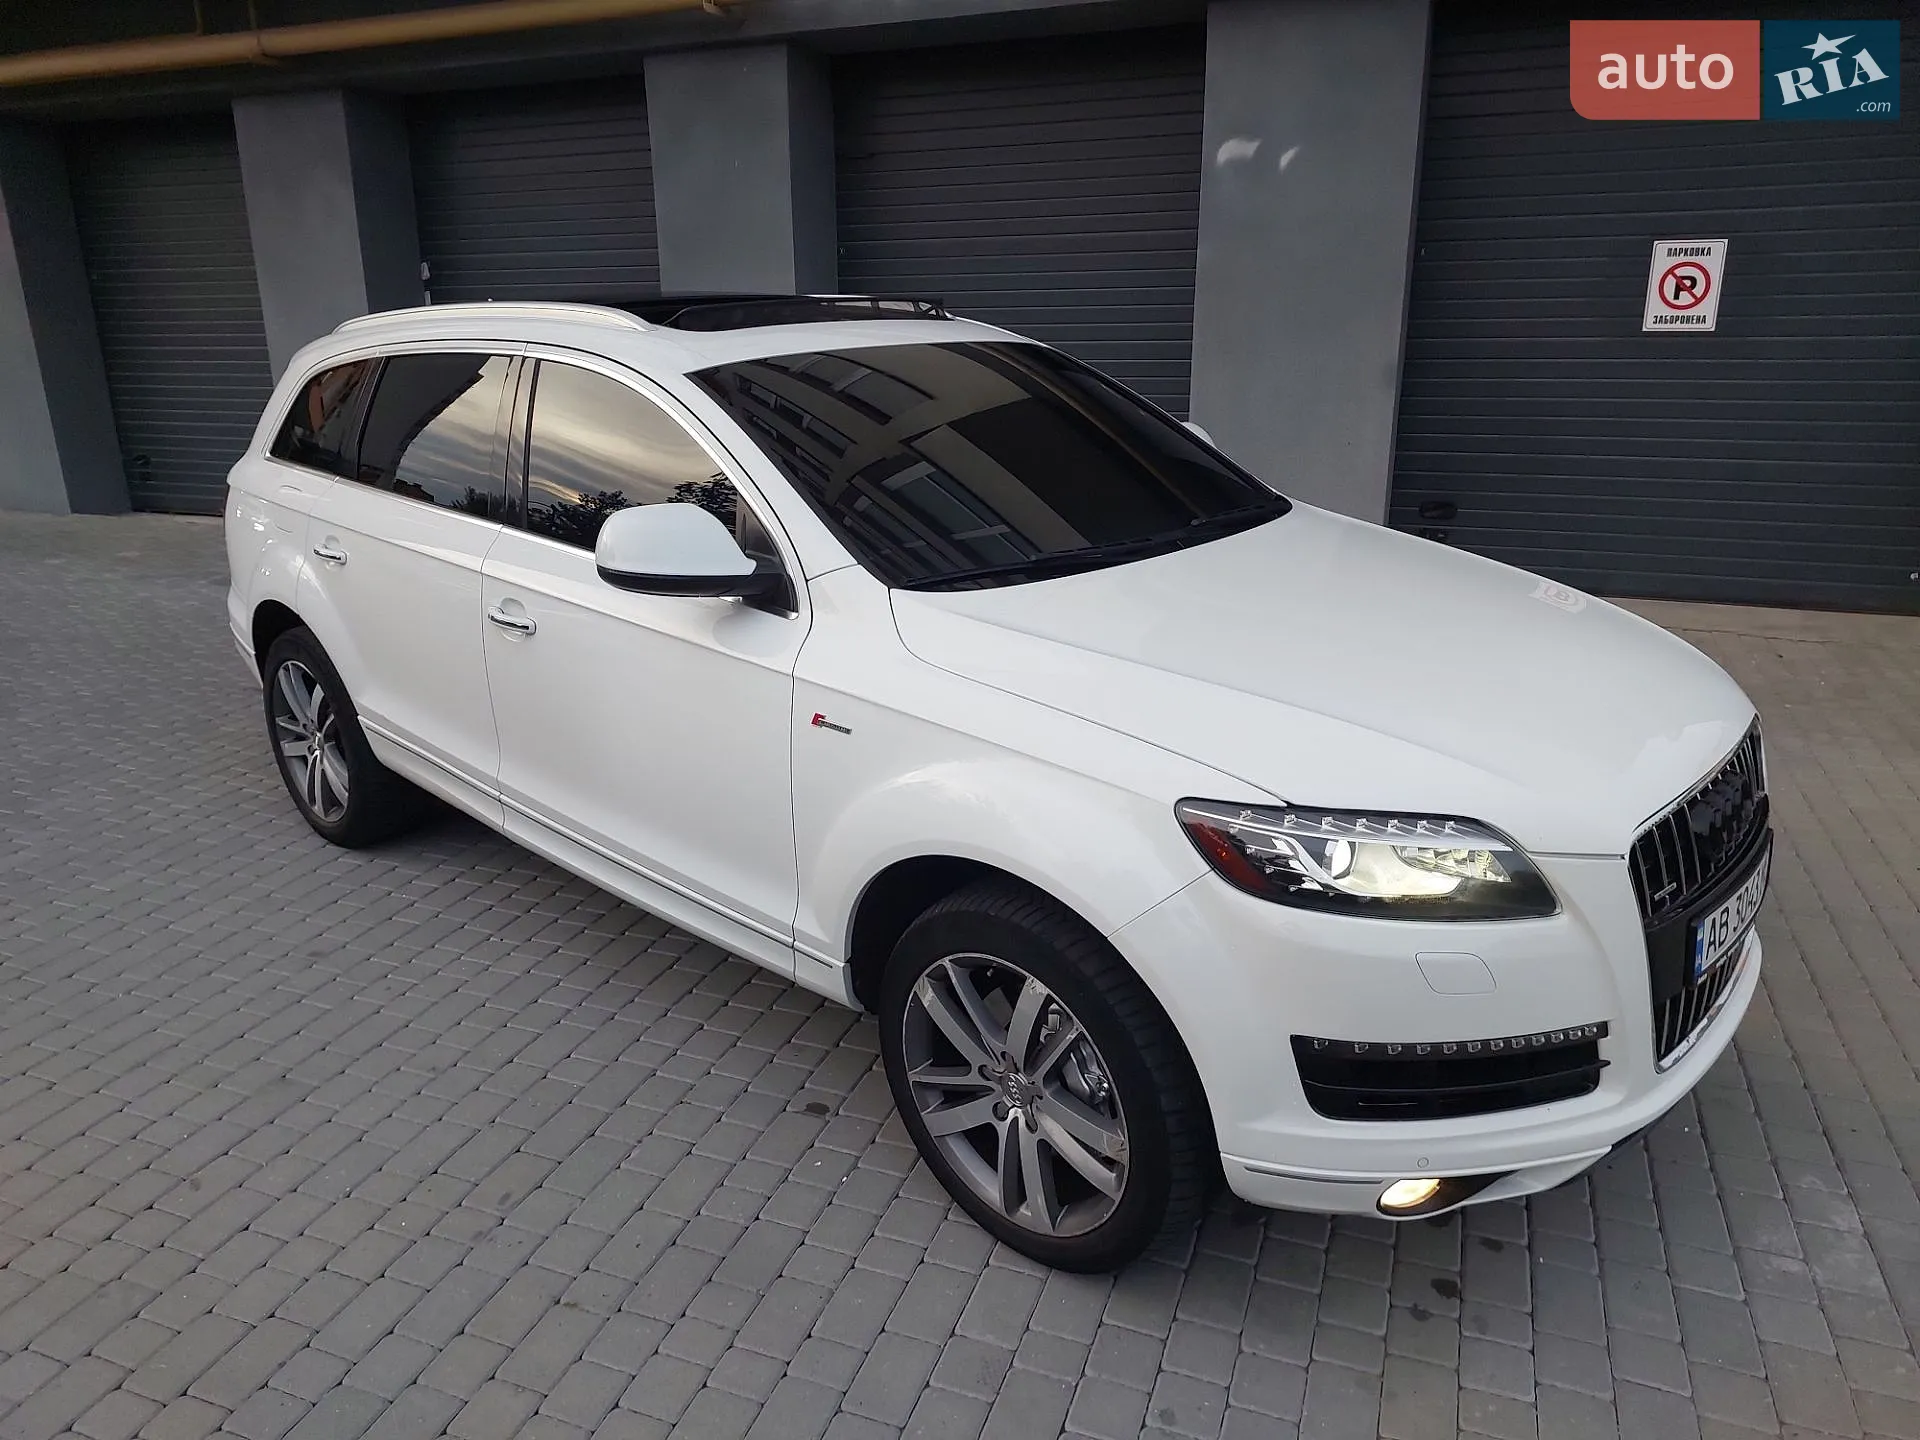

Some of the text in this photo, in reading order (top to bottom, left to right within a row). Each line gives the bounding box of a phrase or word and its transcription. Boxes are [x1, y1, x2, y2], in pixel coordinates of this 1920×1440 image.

[1666, 246, 1712, 257] ПАРКОВКА
[1652, 314, 1707, 325] ЗАБОРОНЕНА
[1705, 906, 1730, 961] AB
